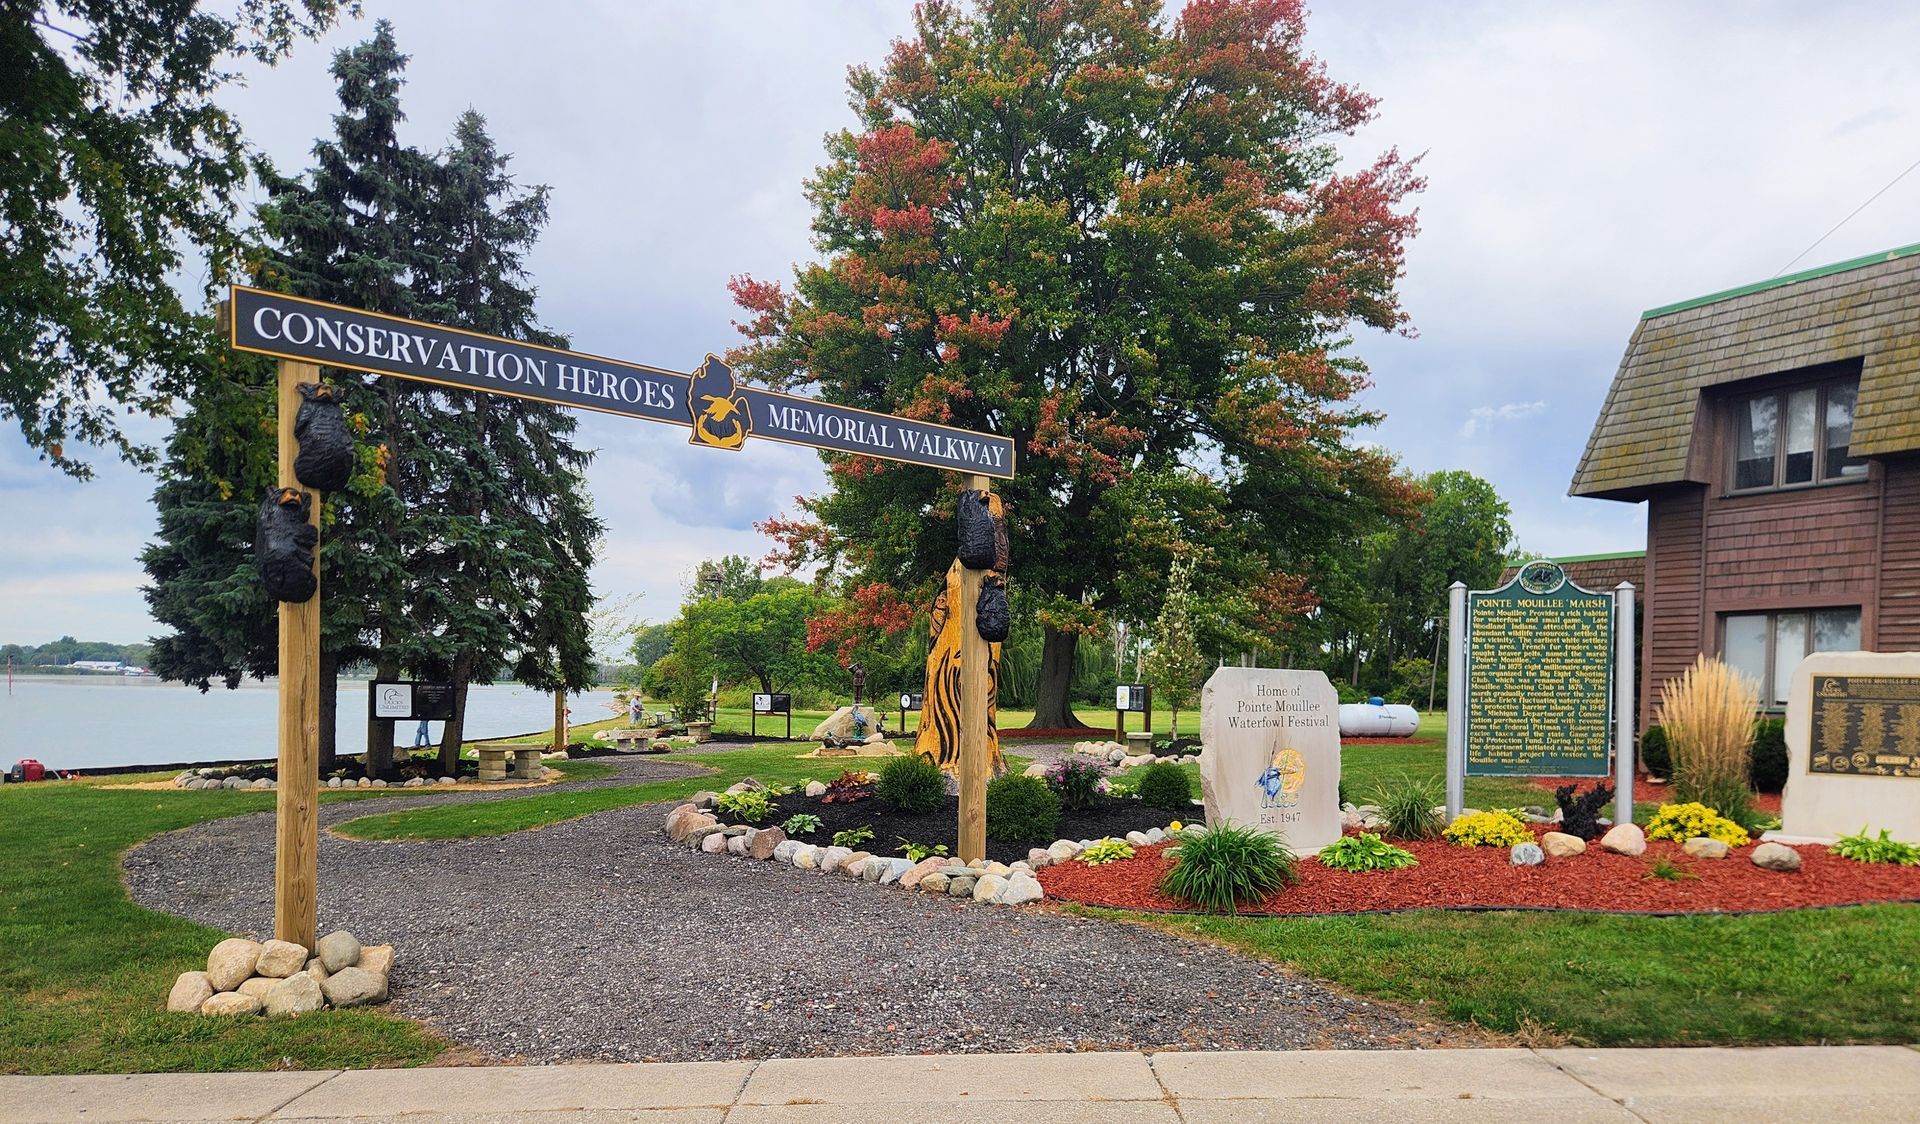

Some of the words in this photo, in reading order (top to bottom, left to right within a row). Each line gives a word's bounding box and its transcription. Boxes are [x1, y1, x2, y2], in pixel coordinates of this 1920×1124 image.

[254, 306, 547, 386] CONSERVATION
[557, 363, 675, 410] HEROES
[768, 404, 893, 448] MEMORIAL
[898, 428, 1005, 467] WALKWAY
[1477, 599, 1511, 608] POINTE
[1518, 599, 1563, 608] MOUILLEE
[1570, 599, 1606, 608] MARSH
[1257, 685, 1288, 697] Home
[1291, 684, 1302, 697] of
[1238, 700, 1272, 713] Pointe
[1275, 700, 1321, 712] Mouillee
[1228, 715, 1284, 729] Waterfowl
[1288, 714, 1329, 728] Festival
[1260, 813, 1278, 824] Est.
[1281, 812, 1301, 823] 1947
